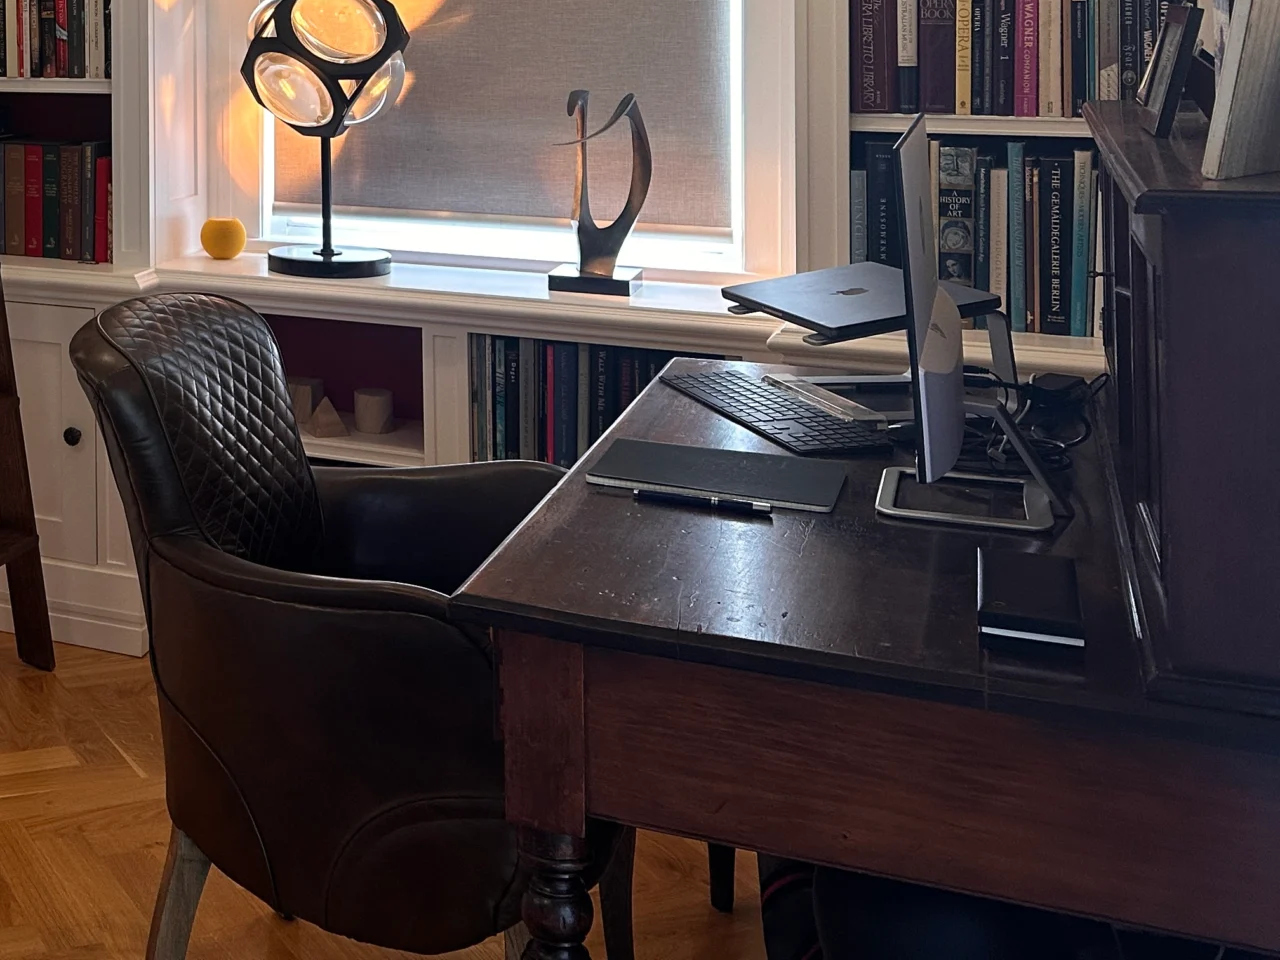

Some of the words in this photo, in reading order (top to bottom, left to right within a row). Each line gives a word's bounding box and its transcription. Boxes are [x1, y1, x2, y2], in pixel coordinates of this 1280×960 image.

[920, 8, 954, 19] BOOK
[957, 7, 970, 52] OPERA
[999, 12, 1011, 48] Wagner
[1023, 2, 1034, 49] WAGNER
[862, 17, 874, 64] LIBRETTO
[901, 34, 909, 54] MUSIC
[1143, 29, 1153, 62] WAGNER
[863, 64, 875, 107] LIBRARY
[1022, 48, 1032, 94] COMPANION
[1051, 168, 1061, 188] THE
[939, 196, 971, 204] HISTORY
[946, 210, 963, 218] ART
[949, 203, 961, 211] OF
[879, 197, 887, 261] MNEMOSYNE
[1051, 191, 1061, 276] GEMÄLDEGALERIE
[1051, 278, 1061, 312] BERLIN
